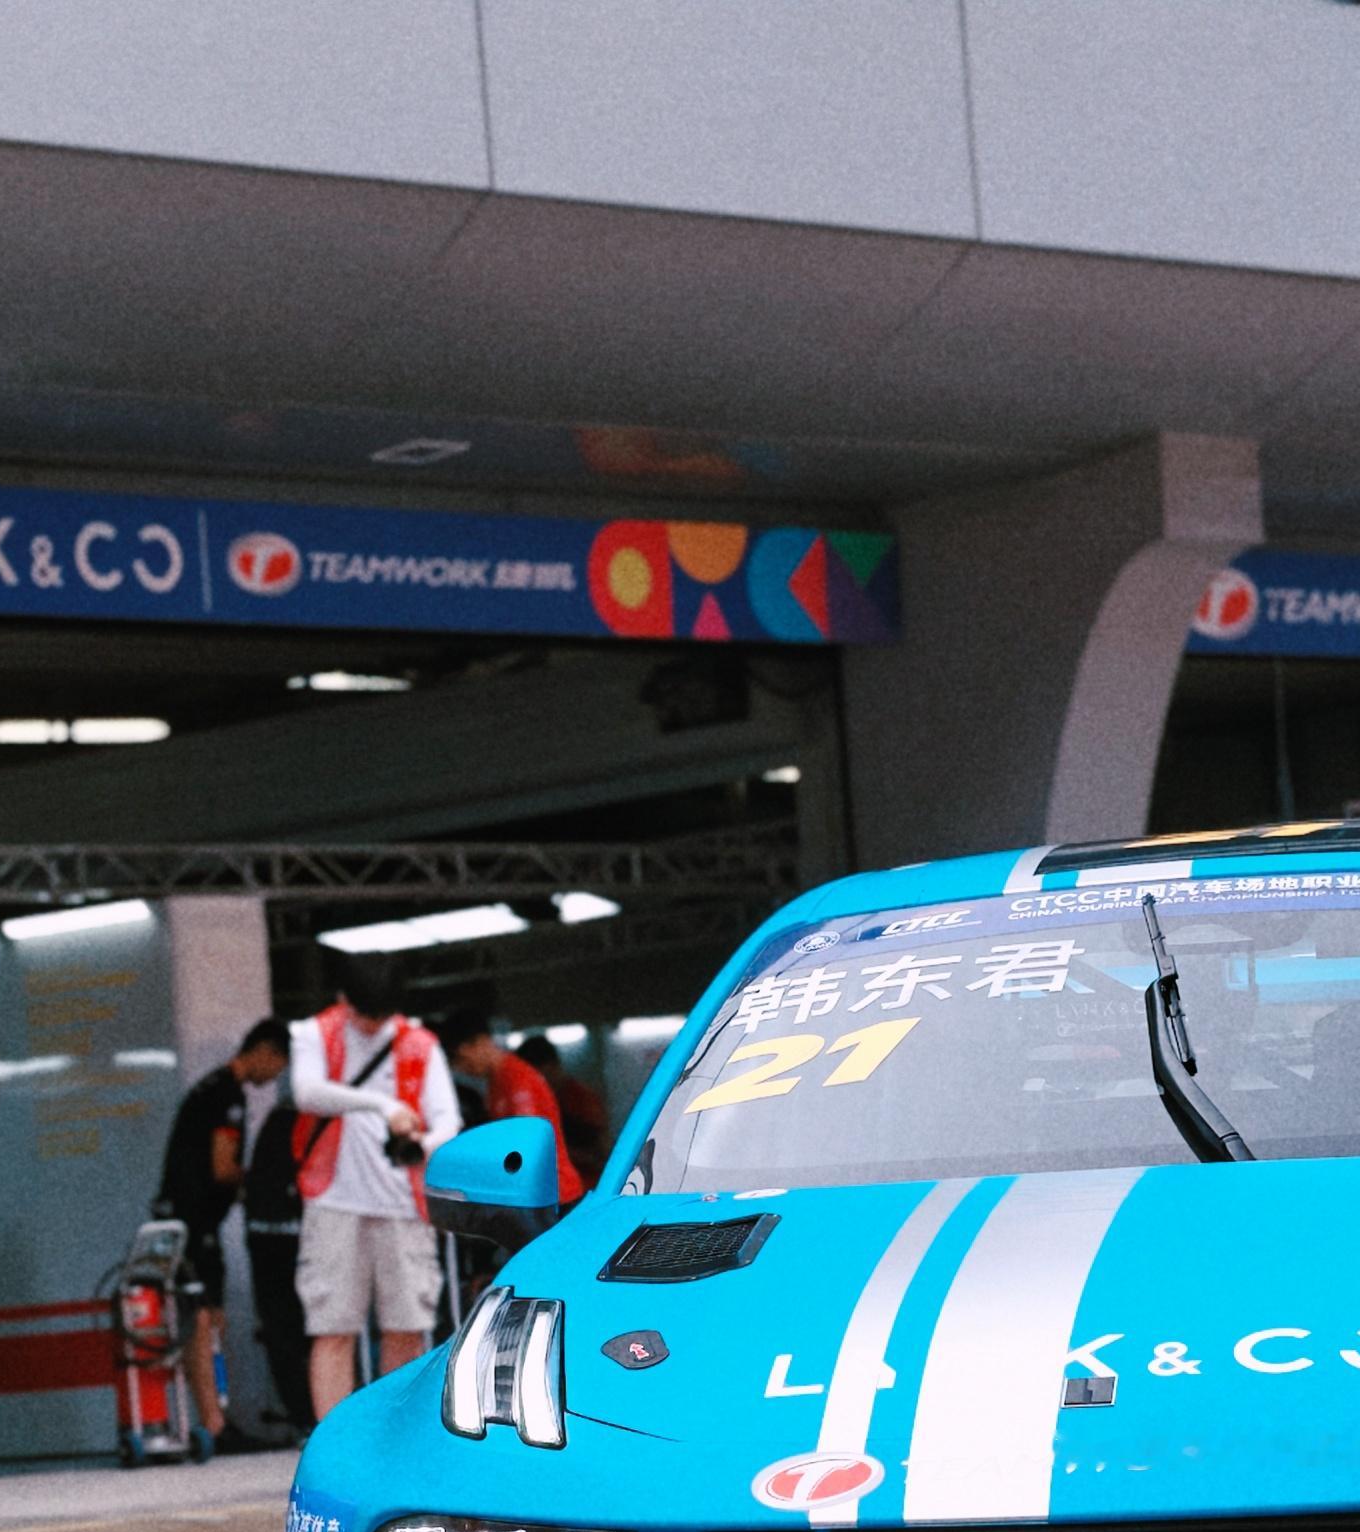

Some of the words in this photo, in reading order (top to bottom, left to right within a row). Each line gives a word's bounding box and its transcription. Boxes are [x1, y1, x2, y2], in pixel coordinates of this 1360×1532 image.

[307, 551, 490, 588] TEAMWORK
[881, 909, 972, 937] CTCC
[1007, 908, 1063, 920] CHINA
[731, 939, 1086, 1034] 韩东君
[683, 1016, 922, 1116] 21
